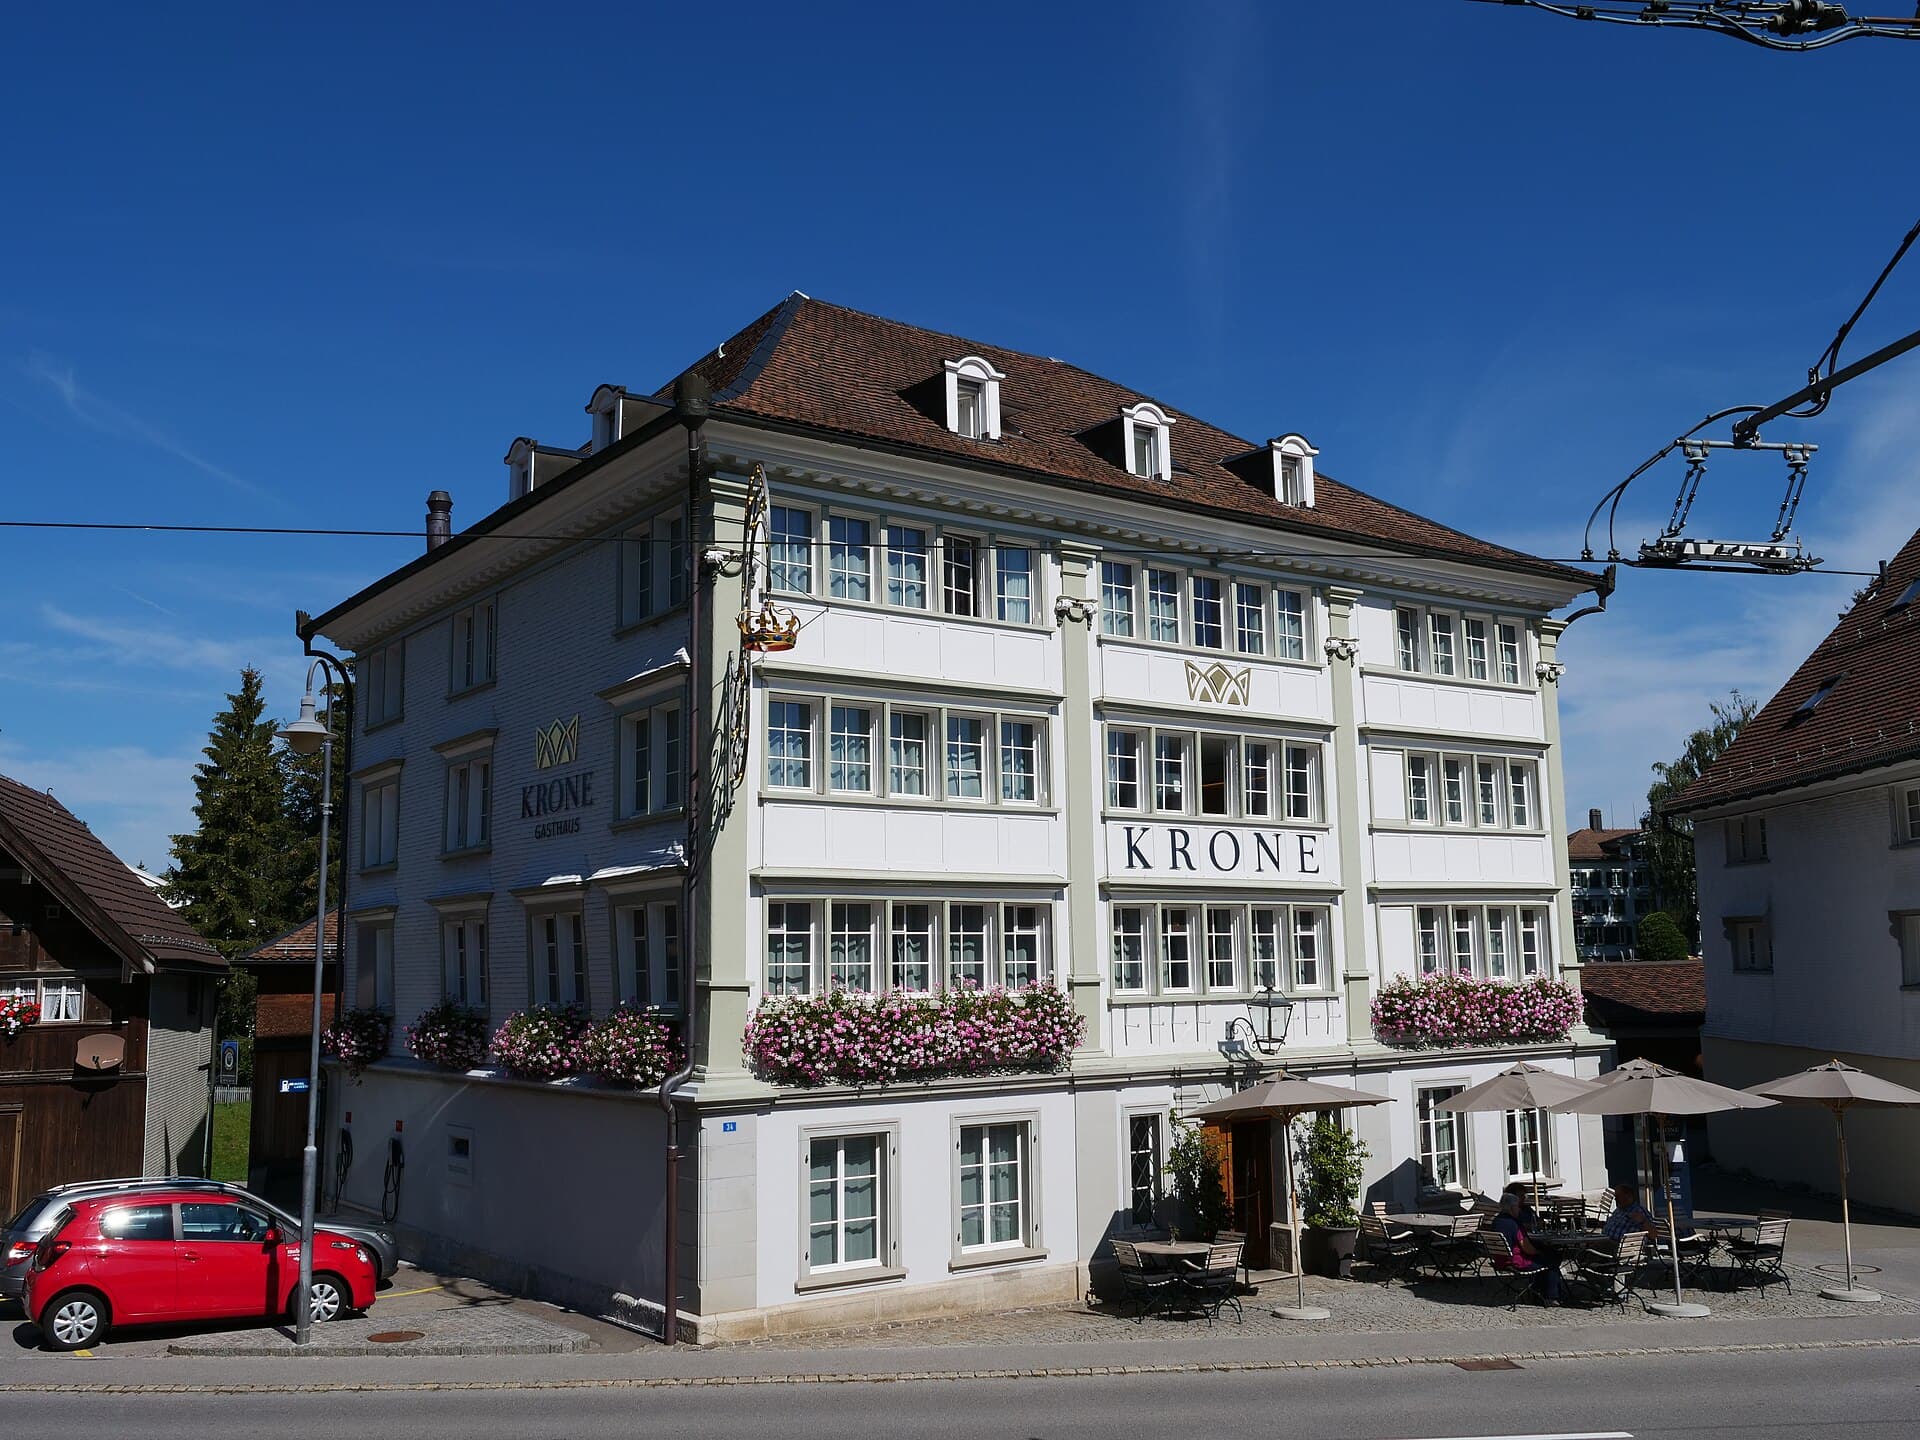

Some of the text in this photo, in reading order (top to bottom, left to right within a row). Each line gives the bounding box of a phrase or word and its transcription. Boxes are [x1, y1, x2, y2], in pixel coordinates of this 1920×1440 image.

[521, 771, 594, 818] KRONE
[534, 817, 580, 839] GASTHAUS
[1123, 826, 1320, 874] KRONE
